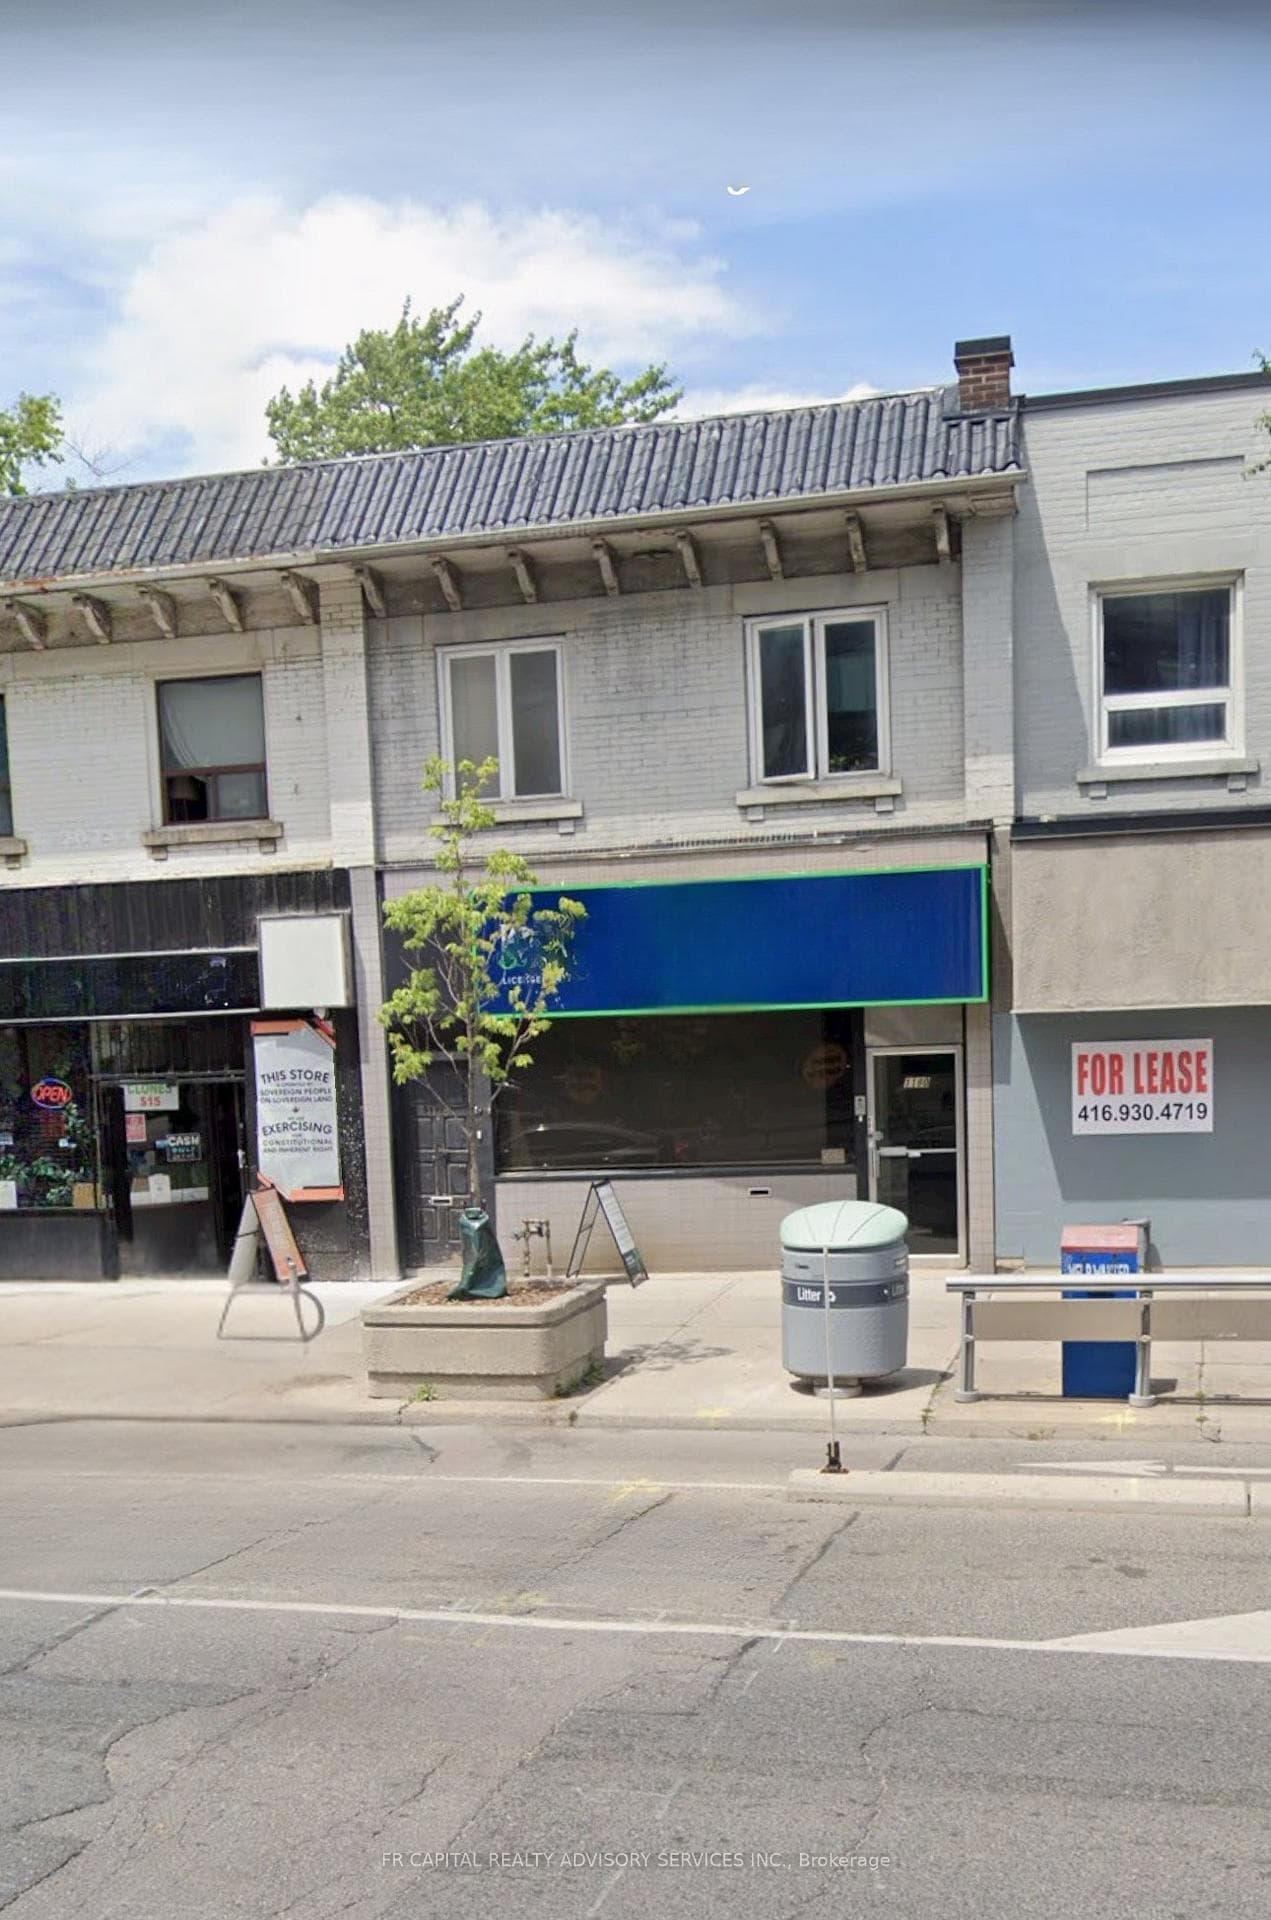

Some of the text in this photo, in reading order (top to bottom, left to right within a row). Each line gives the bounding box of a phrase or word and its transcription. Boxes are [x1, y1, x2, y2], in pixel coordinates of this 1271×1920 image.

[260, 1069, 330, 1085] THIS STORE
[1077, 1051, 1208, 1096] FOR LEASE
[35, 1085, 71, 1106] OPEN
[1078, 1102, 1208, 1122] 416.930.4719
[262, 1121, 333, 1137] EXERCISING
[167, 1135, 200, 1147] CASH
[797, 1286, 822, 1302] Litter
